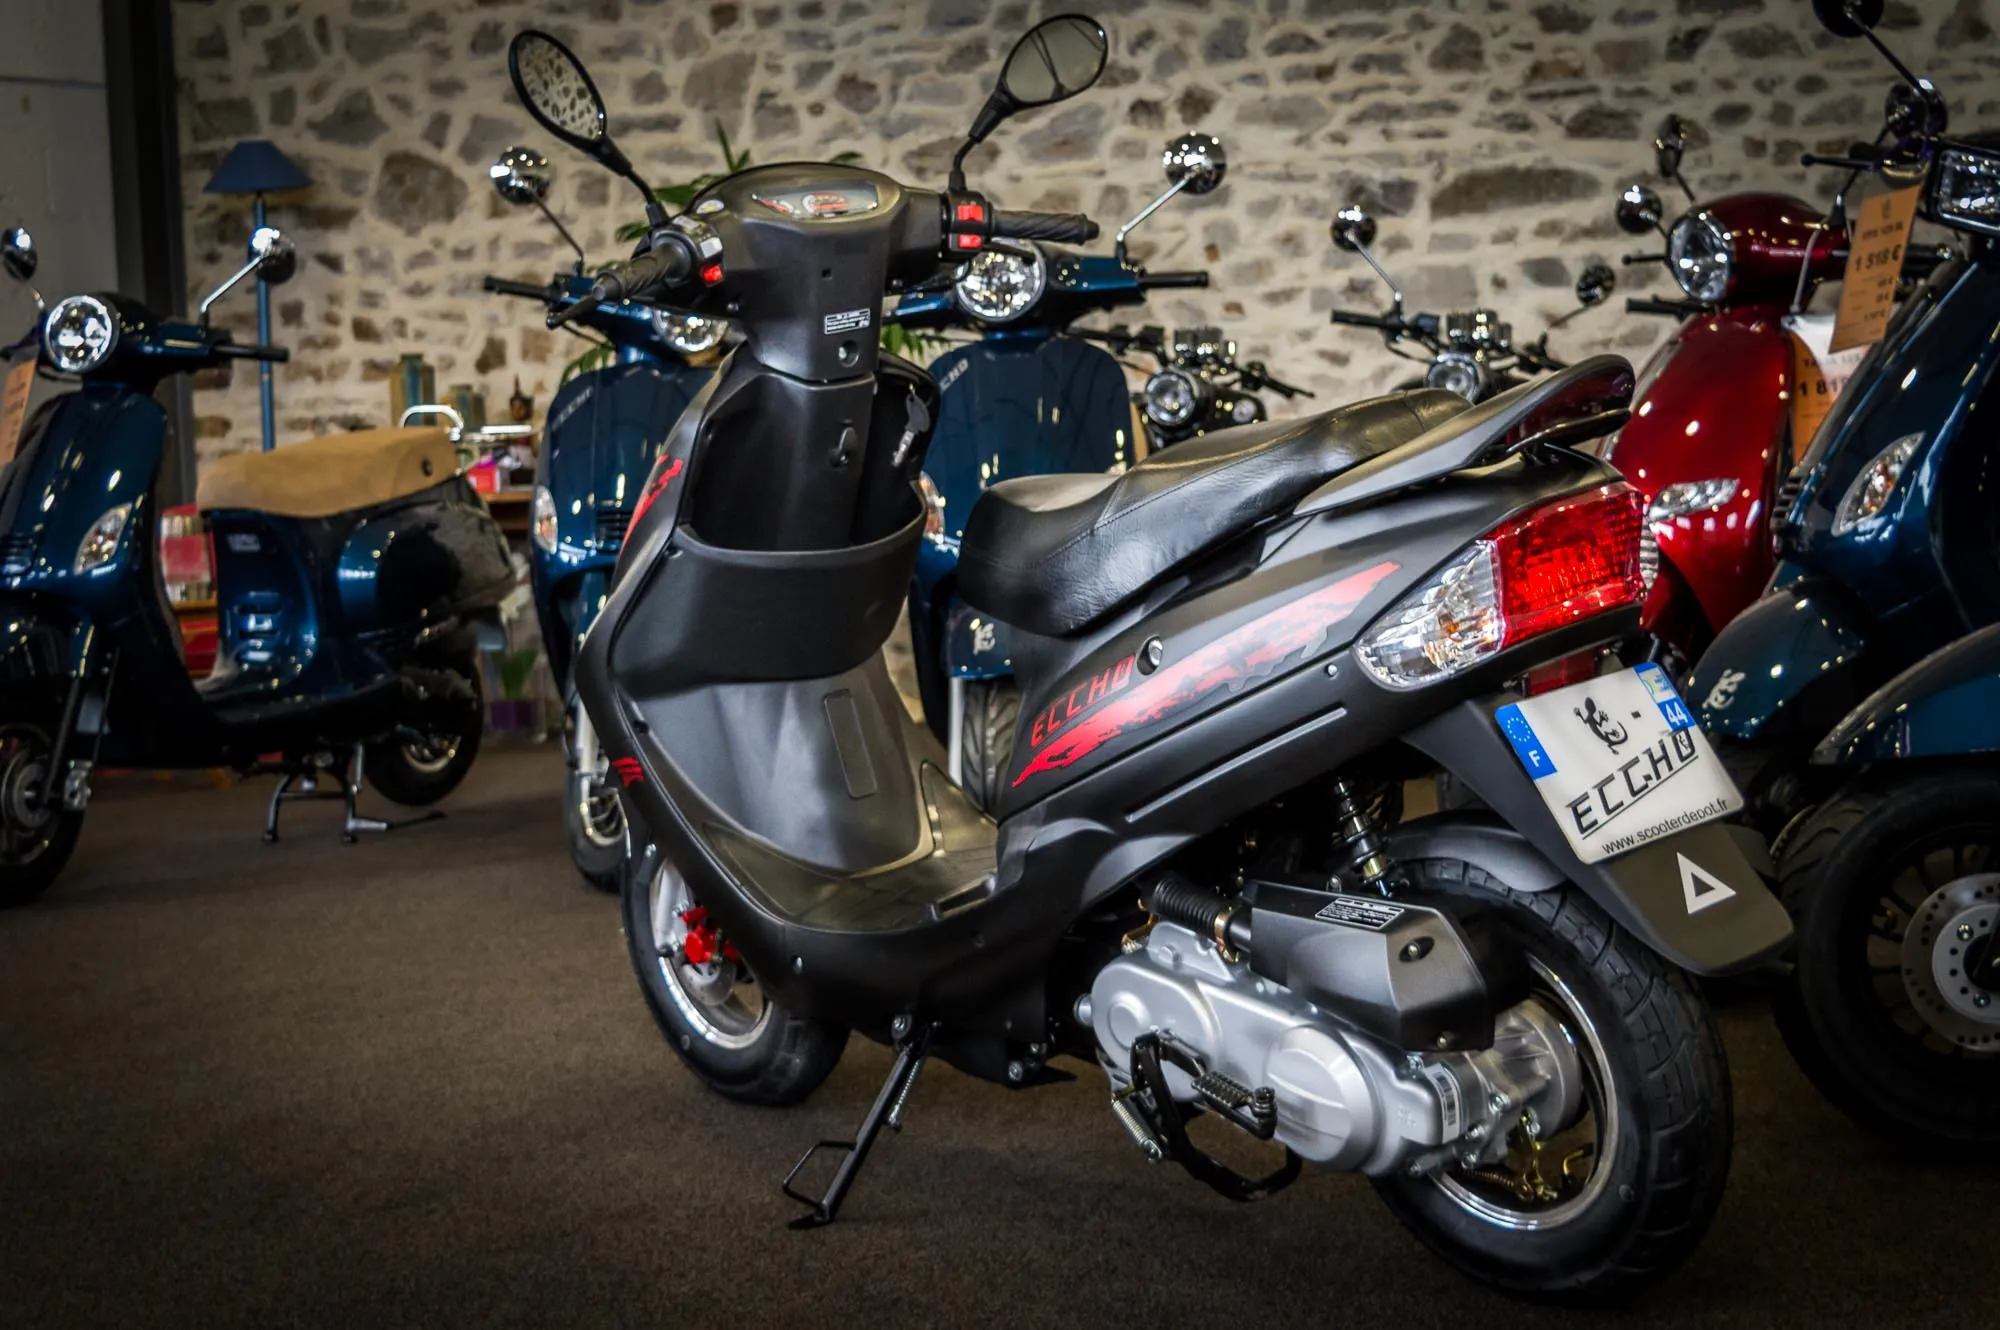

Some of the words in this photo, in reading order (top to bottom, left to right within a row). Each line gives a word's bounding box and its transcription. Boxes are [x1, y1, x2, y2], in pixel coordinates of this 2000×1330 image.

[1030, 654, 1135, 746] ECCHO
[1665, 703, 1687, 727] 44
[1528, 749, 1541, 767] F
[1566, 728, 1697, 836] ECCHO
[1602, 798, 1728, 854] www.scooterdepot.fr
